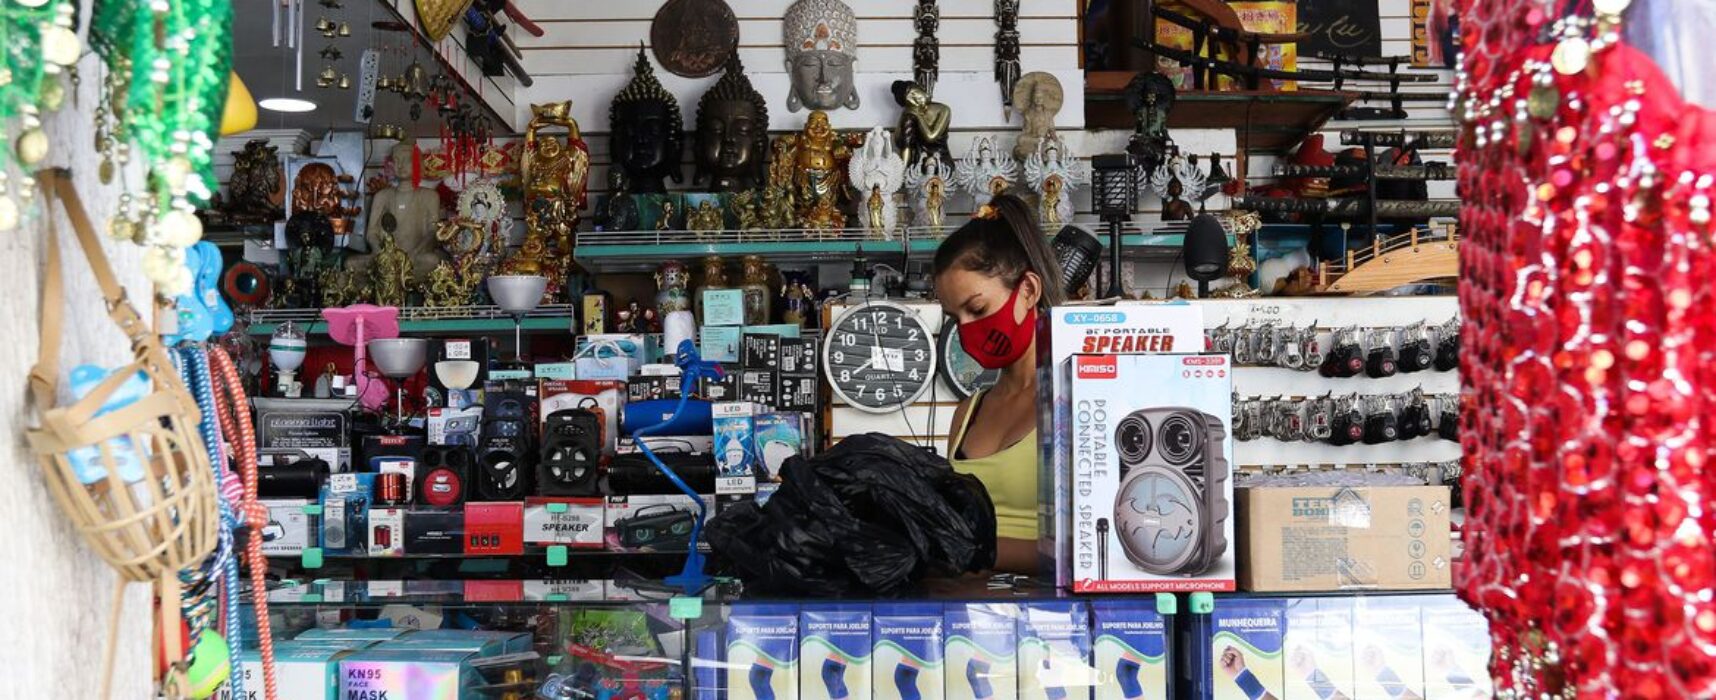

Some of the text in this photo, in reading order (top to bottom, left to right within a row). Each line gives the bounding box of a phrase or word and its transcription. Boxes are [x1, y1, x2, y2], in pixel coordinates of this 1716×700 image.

[852, 318, 867, 330] 11
[895, 317, 902, 329] 1
[1073, 313, 1118, 323] XY-0658
[908, 329, 919, 341] 2
[1104, 327, 1170, 335] PORTABLE
[839, 333, 856, 346] 10
[1082, 335, 1174, 353] SPEAKER
[833, 351, 844, 364] 9
[914, 349, 925, 362] 3
[840, 369, 851, 383] 8
[908, 368, 919, 381] 4
[856, 384, 866, 398] 7
[875, 388, 886, 401] 6
[893, 384, 903, 397] 5
[723, 405, 741, 413] LED
[1093, 400, 1107, 477] PORTABLE
[1077, 400, 1093, 570] CONNECTED SPEAKER
[542, 523, 589, 532] SPEAKER
[1175, 582, 1225, 590] MICROPHONE
[1218, 618, 1277, 627] MUNHEQUEIRA
[735, 626, 796, 634] SUPORTE PARA JOELHO
[348, 668, 382, 679] KN95
[348, 690, 388, 700] MASK
